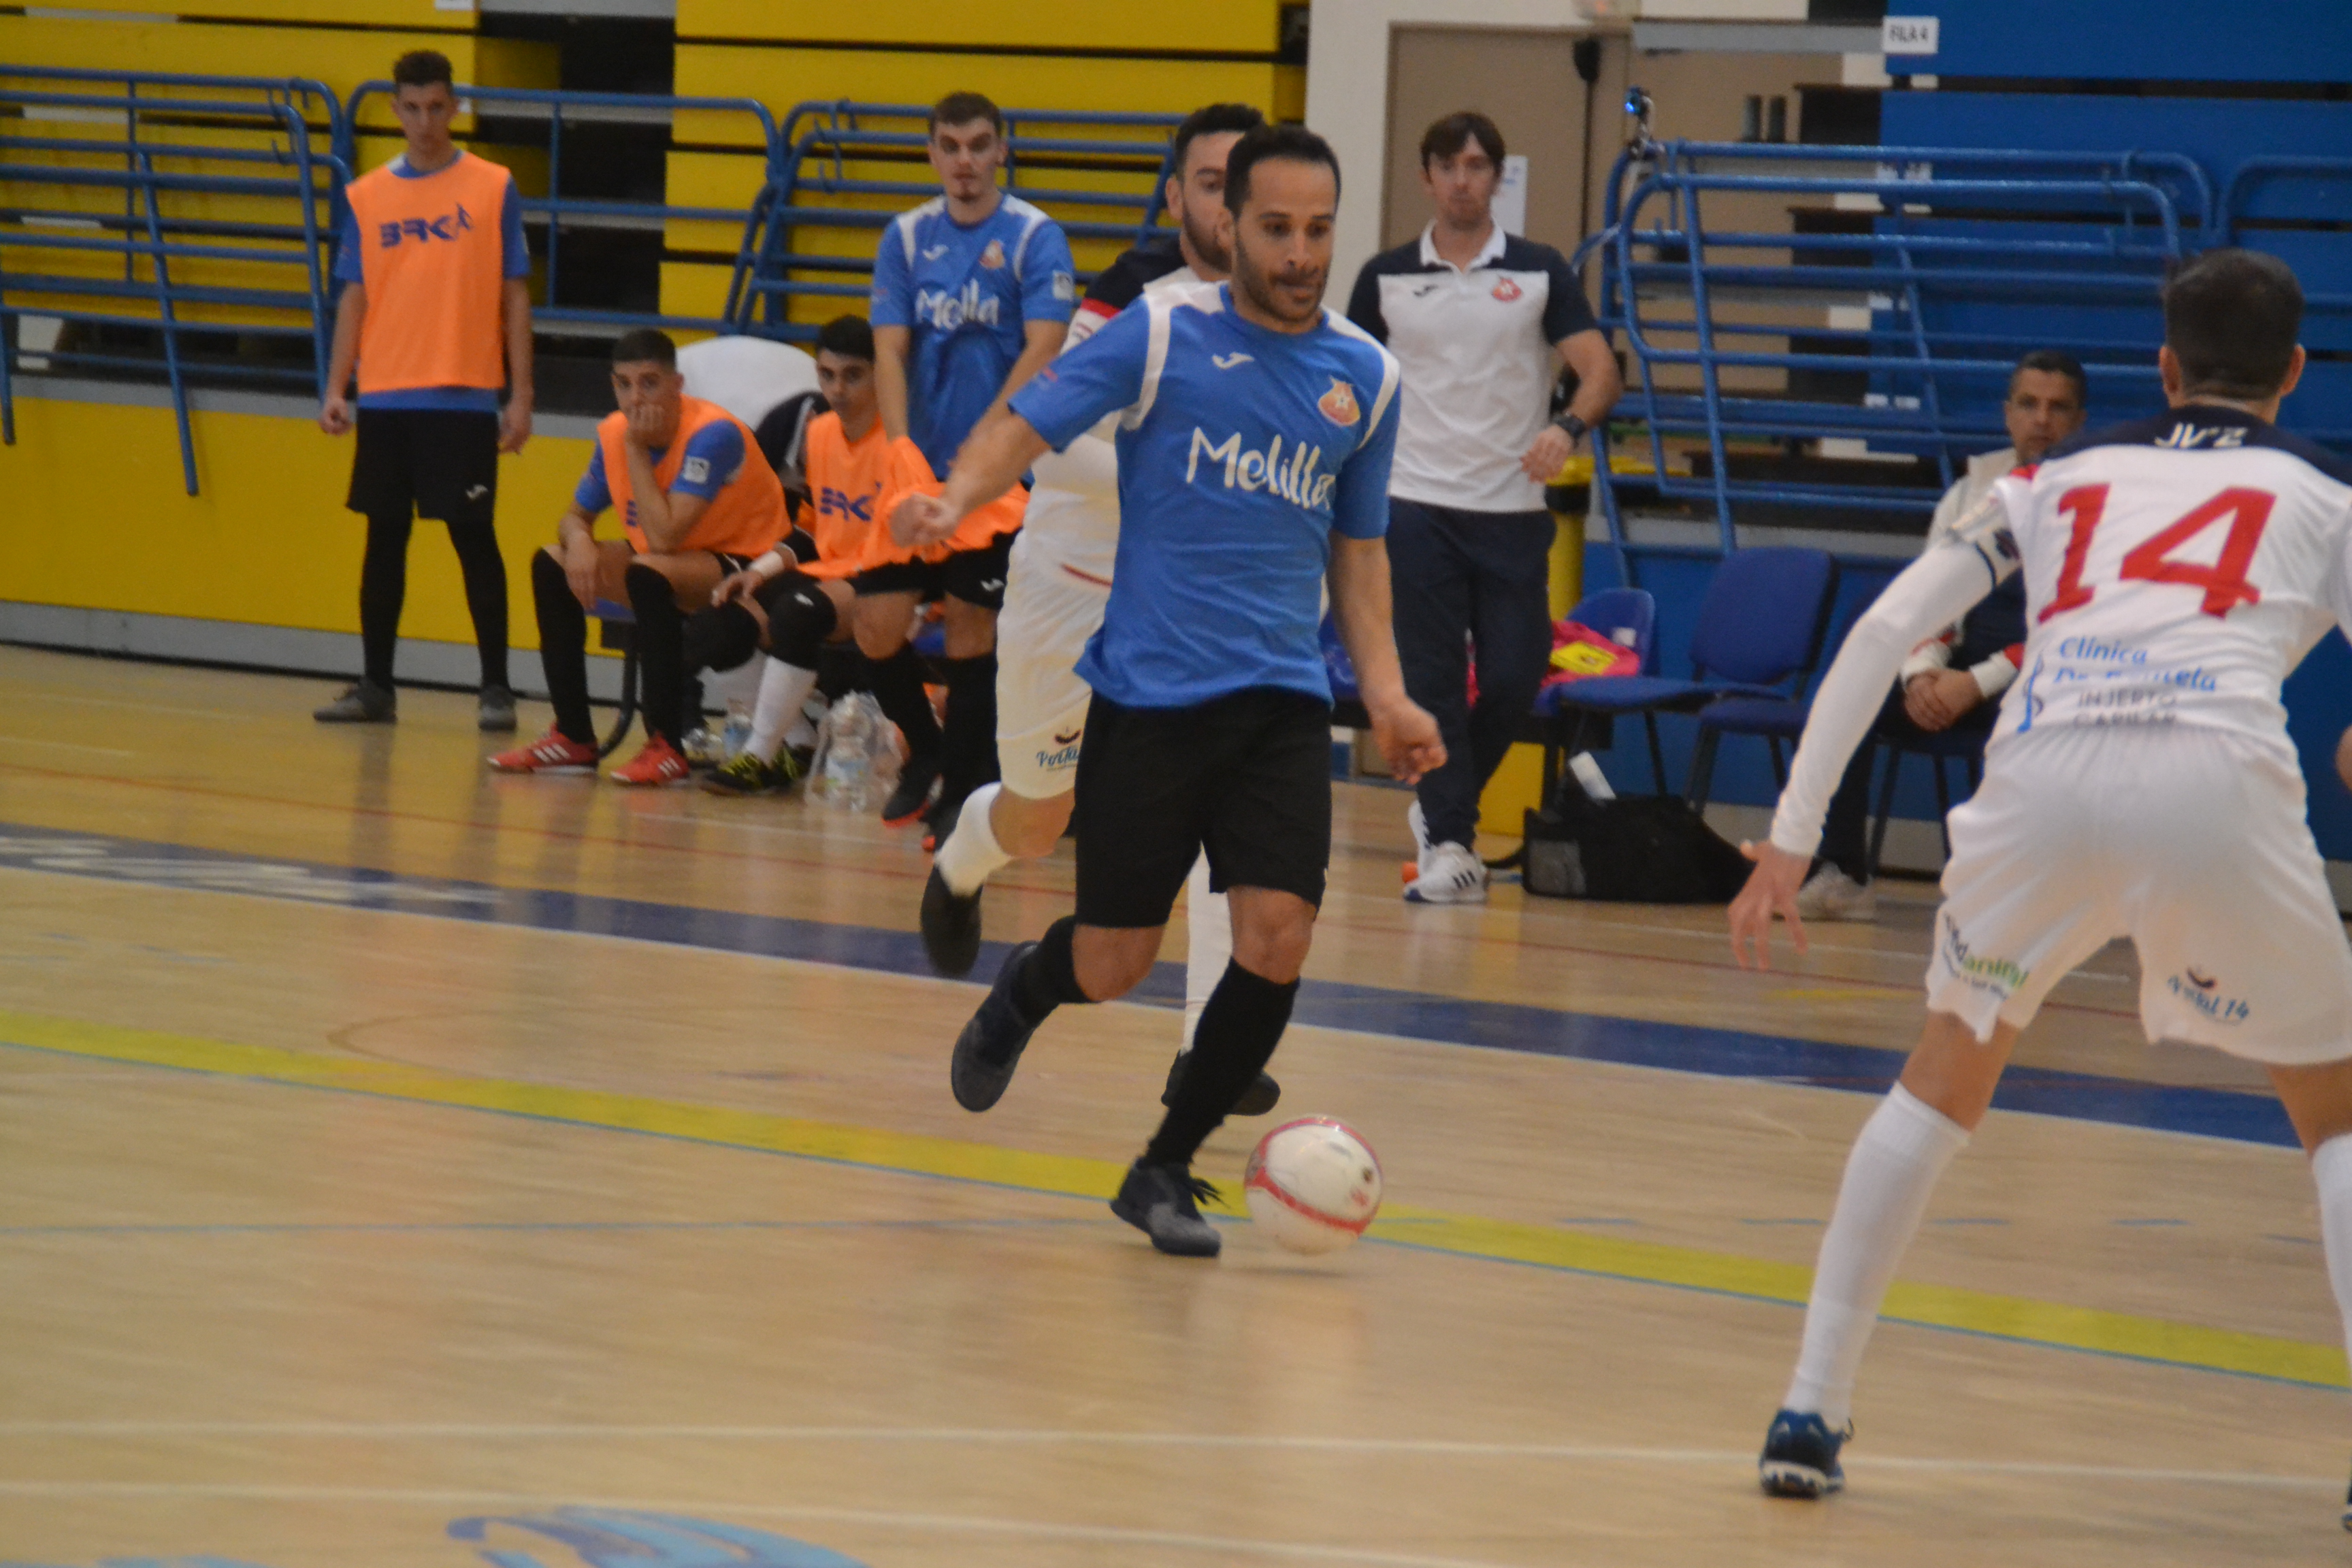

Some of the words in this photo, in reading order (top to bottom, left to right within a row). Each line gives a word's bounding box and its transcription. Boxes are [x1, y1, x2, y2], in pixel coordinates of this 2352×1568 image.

[1889, 24, 1918, 43] FILA
[1186, 426, 1336, 510] Melilla
[2038, 483, 2277, 623] 14
